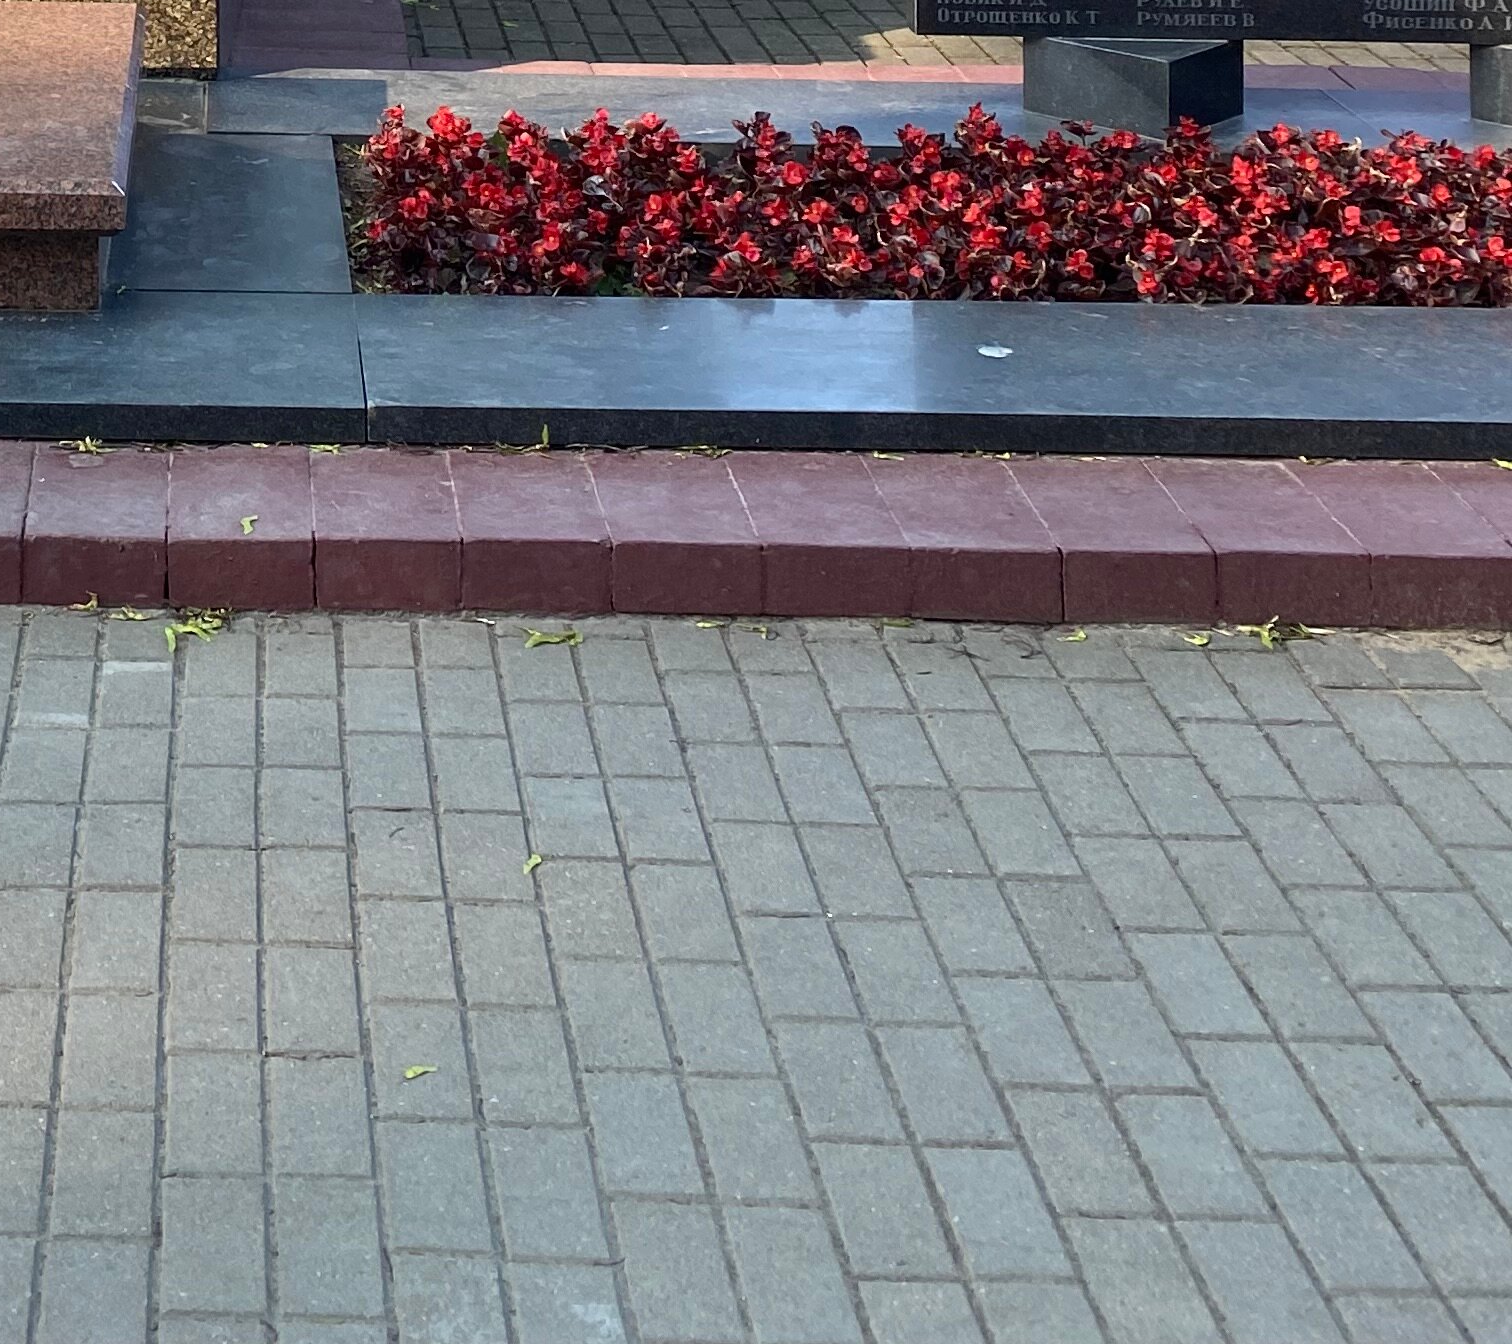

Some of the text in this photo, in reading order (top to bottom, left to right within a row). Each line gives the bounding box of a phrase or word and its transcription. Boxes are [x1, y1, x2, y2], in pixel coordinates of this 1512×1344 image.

[1066, 10, 1079, 24] К
[1086, 11, 1100, 24] Т
[1243, 13, 1254, 26] В
